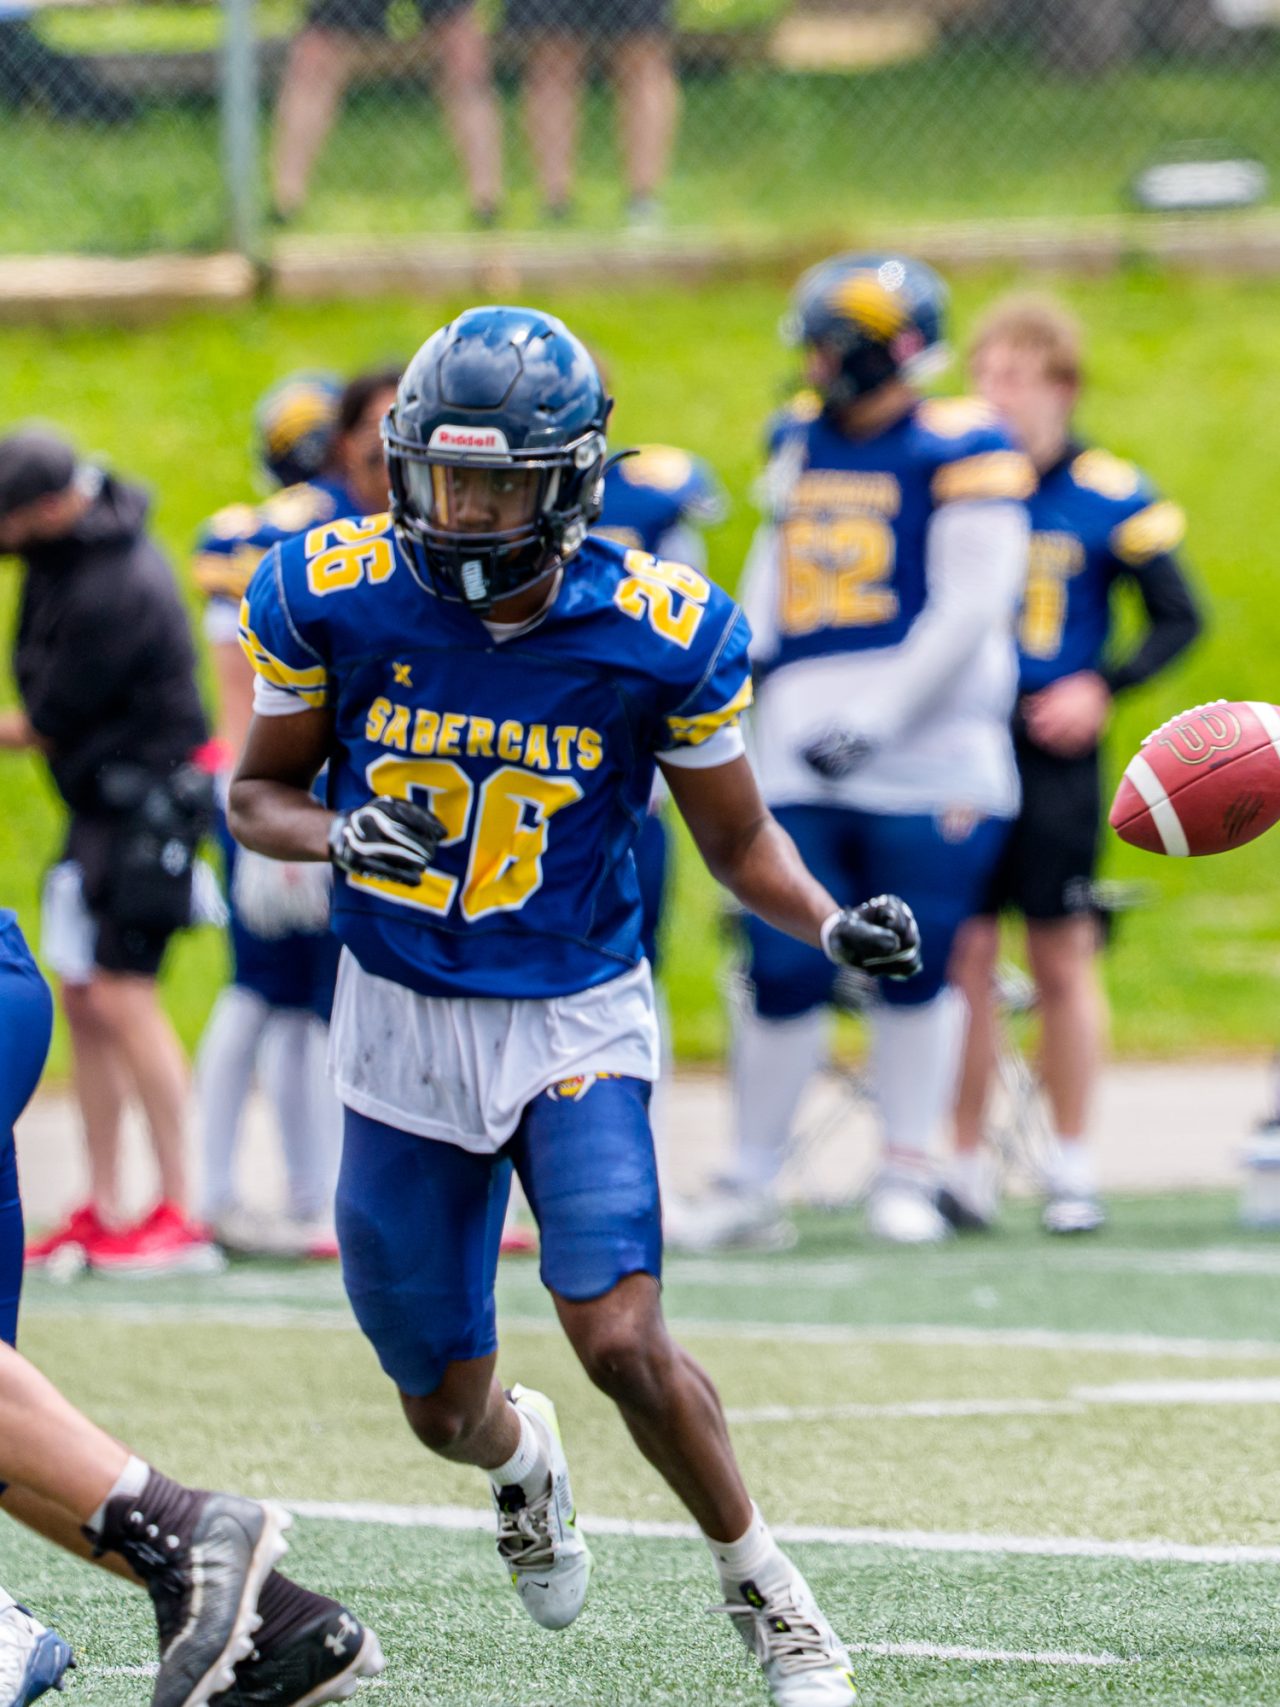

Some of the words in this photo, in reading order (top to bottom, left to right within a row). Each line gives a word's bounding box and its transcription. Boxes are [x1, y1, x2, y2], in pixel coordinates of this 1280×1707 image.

[438, 431, 497, 448] Riddell
[305, 512, 396, 597] 26
[615, 548, 712, 649] 26
[366, 696, 604, 771] SABERCATS
[345, 753, 585, 923] 26
